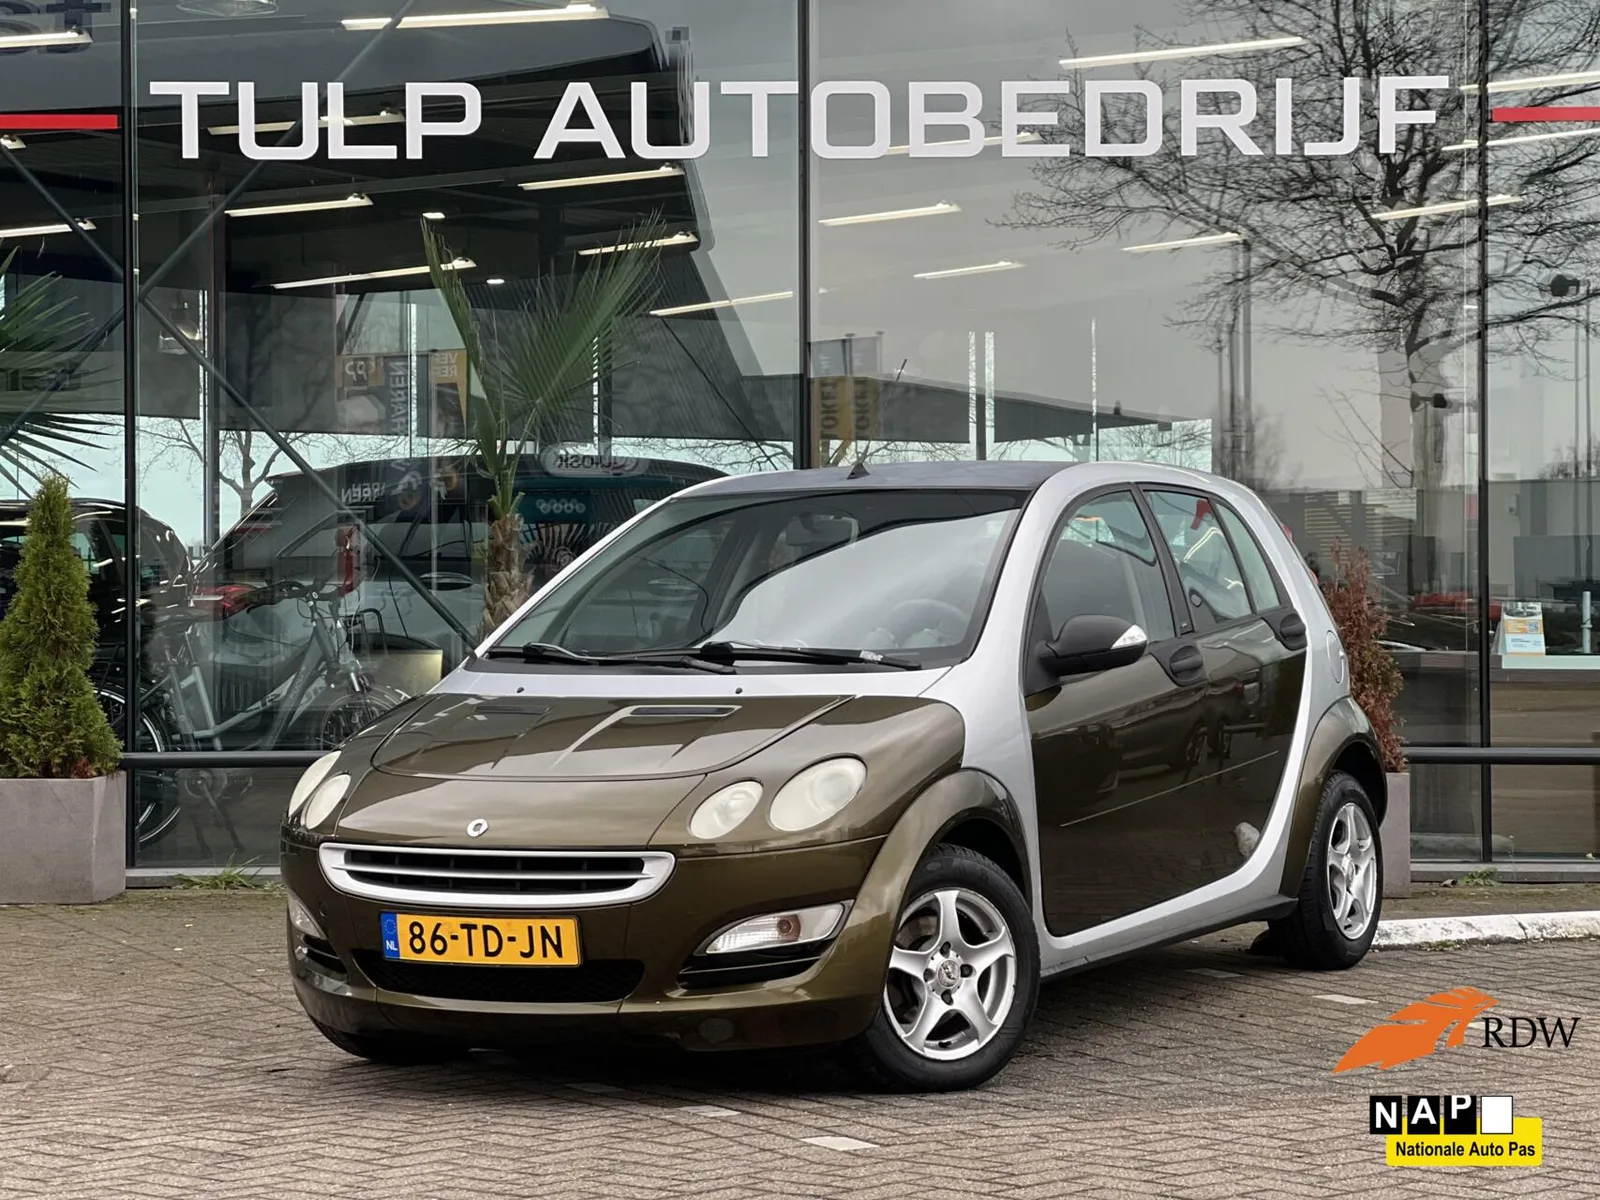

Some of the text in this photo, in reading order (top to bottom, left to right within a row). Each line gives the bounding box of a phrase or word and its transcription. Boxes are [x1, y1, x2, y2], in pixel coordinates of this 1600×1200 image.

[149, 75, 1450, 160] TULP AUTOBEDRIJF
[385, 940, 398, 951] NL
[409, 921, 563, 958] 86-TD-JN
